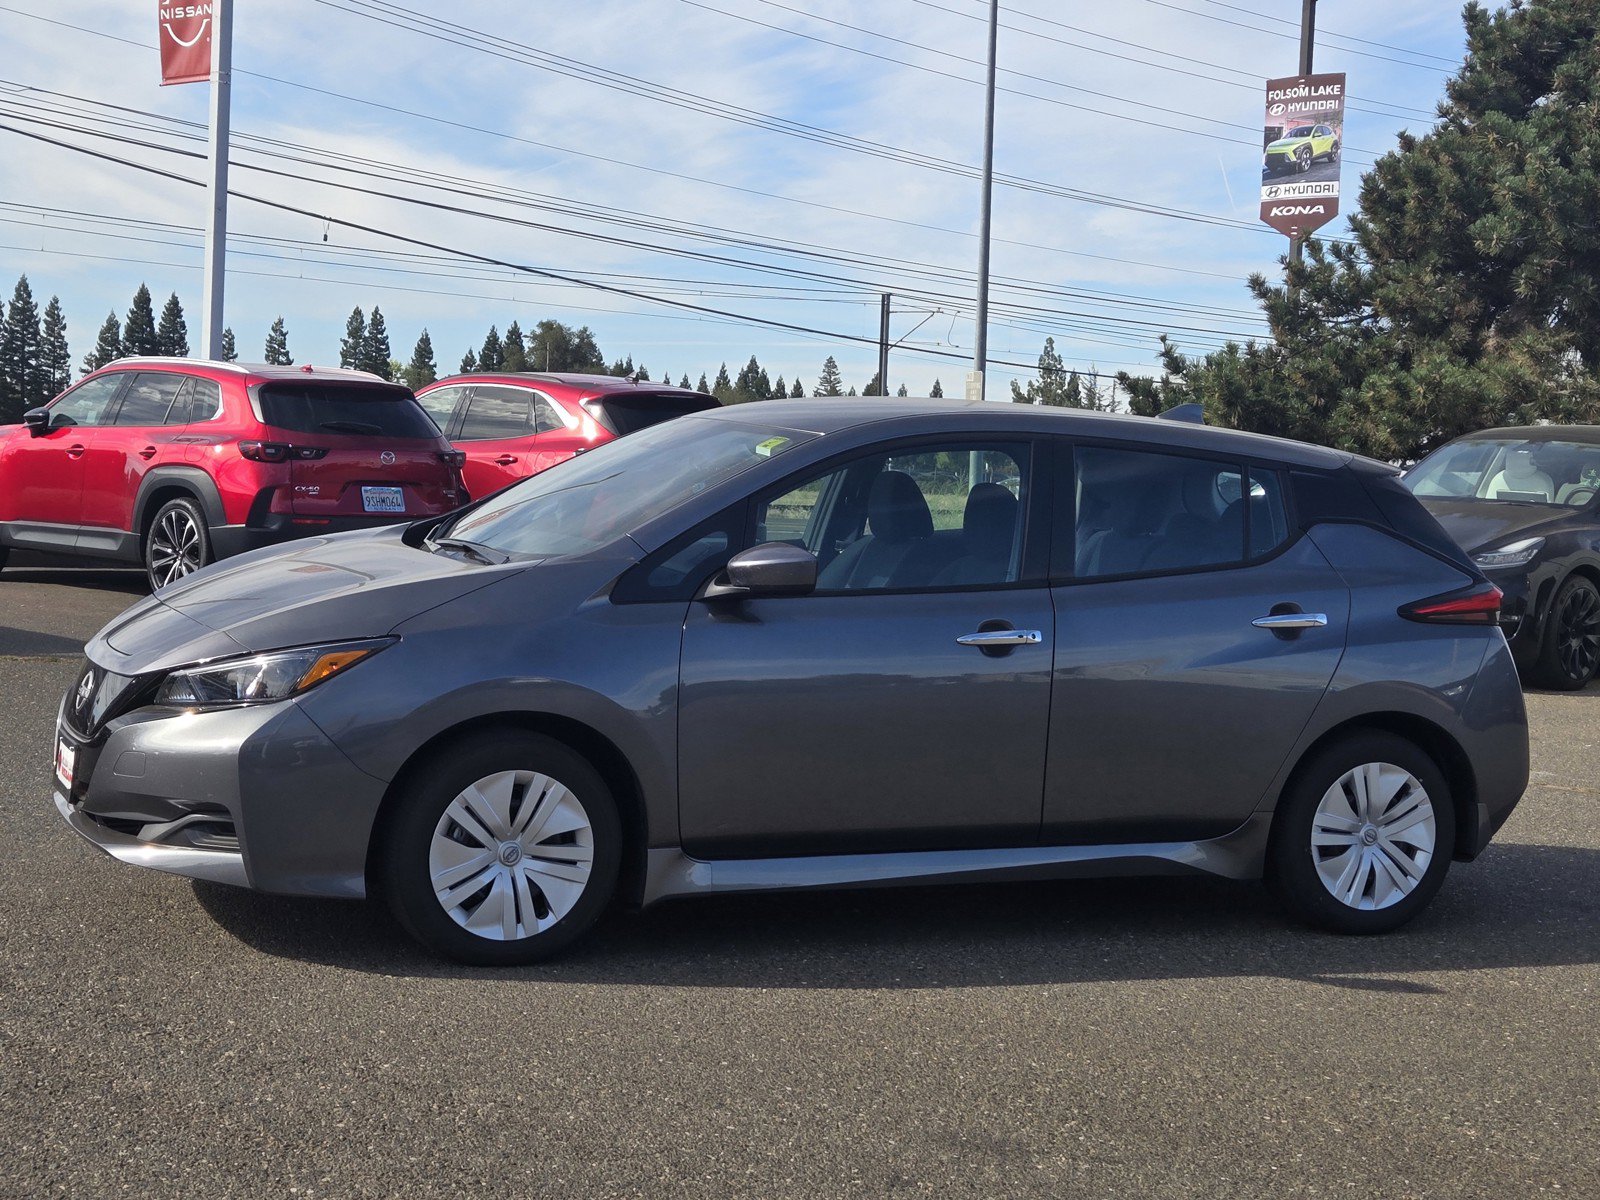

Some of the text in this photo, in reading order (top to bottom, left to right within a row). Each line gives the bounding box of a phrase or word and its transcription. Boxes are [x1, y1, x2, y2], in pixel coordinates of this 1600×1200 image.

[160, 3, 212, 20] NISSAN
[1268, 85, 1341, 101] FOLSOM LAKE
[1287, 100, 1339, 112] HYUNDAI
[1284, 184, 1334, 195] HYUNDAI
[1270, 205, 1325, 217] KONA
